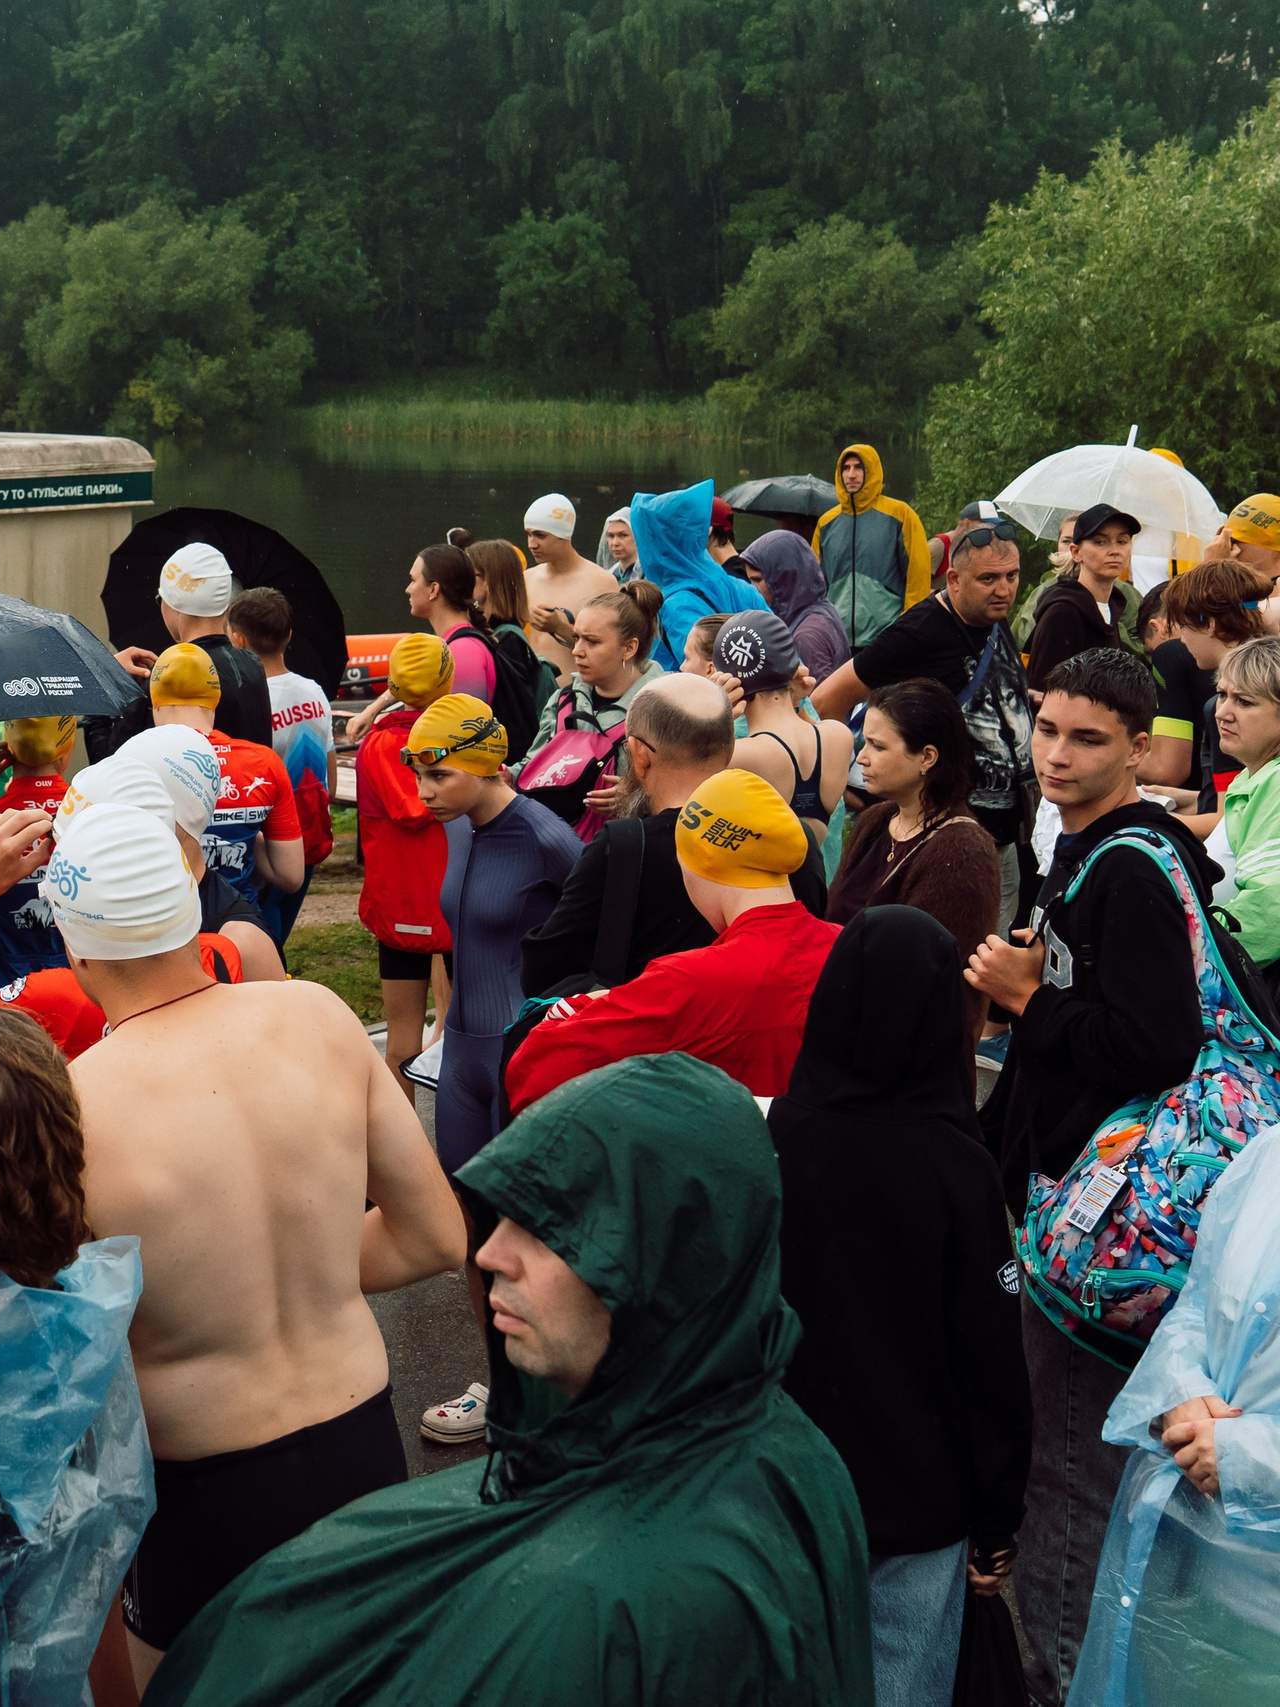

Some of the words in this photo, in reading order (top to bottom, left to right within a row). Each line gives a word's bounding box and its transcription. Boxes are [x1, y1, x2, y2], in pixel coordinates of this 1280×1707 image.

[11, 489, 25, 500] ТО
[27, 485, 83, 499] «ТУЛЬСКИЕ
[86, 484, 123, 496] ПАРКИ»
[721, 626, 747, 664] МОСКОВСКАЯ
[747, 628, 763, 646] ЛИГА
[737, 648, 766, 678] ПЛАВАНИЯ
[271, 701, 325, 731] RUSSIA
[163, 757, 204, 791] ФЕДЕРАЦИЯ
[169, 768, 203, 799] ТУЛЬСКОЙ
[23, 799, 62, 810] Зуб
[213, 811, 244, 821] BIKE
[708, 825, 746, 842] SUP
[715, 817, 762, 840] SWIM
[701, 832, 740, 851] RUN
